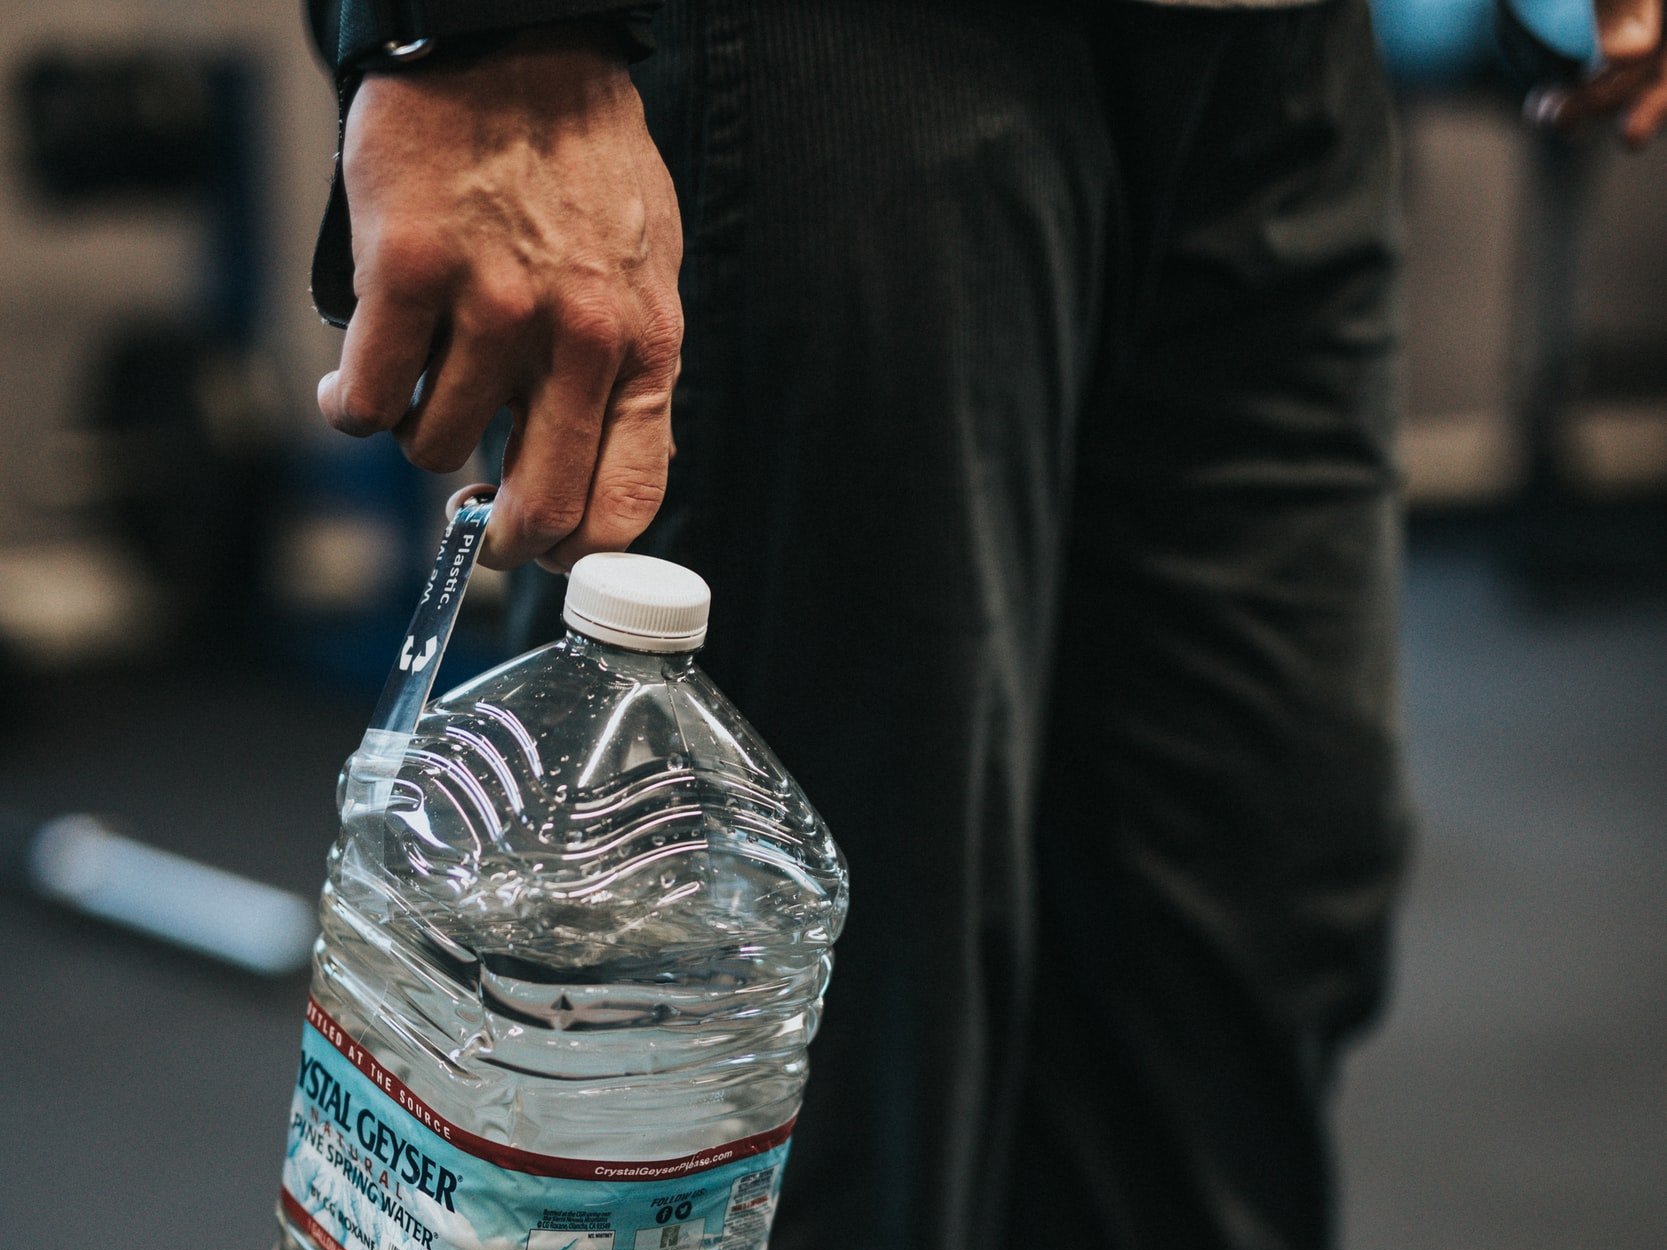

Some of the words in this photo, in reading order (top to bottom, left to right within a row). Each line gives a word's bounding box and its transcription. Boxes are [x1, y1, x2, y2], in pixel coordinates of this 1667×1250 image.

[437, 534, 475, 610] Plastic.
[299, 1050, 352, 1133] YSTAL
[348, 1045, 364, 1066] AT
[370, 1063, 392, 1092] THE
[399, 1089, 452, 1140] SOURCE
[292, 1112, 324, 1155] PINE
[326, 1144, 379, 1205] SPRING
[310, 1105, 403, 1201] NATURAL
[650, 1191, 692, 1208] FOLLOW
